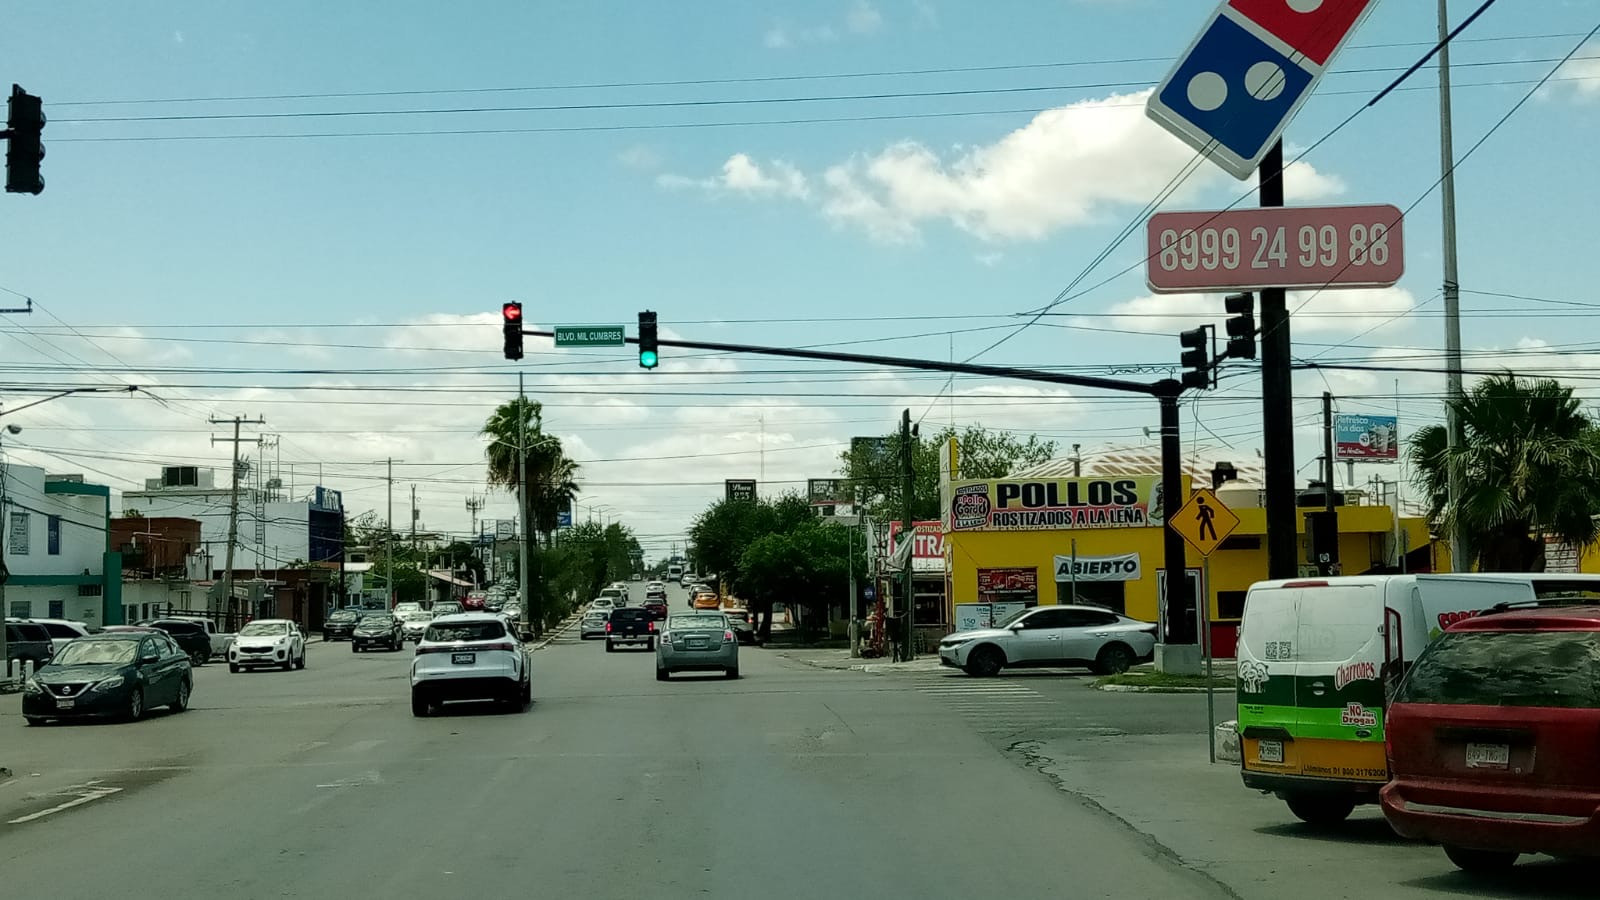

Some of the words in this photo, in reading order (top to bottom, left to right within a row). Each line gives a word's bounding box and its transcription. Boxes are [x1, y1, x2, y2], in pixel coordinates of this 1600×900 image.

[1159, 228, 1241, 271] 8999
[1251, 226, 1288, 269] 24
[1298, 224, 1338, 268] 99
[1349, 222, 1389, 266] 88
[557, 332, 577, 341] BLVD.
[577, 332, 589, 341] MIL
[589, 331, 622, 341] CUMBRES
[996, 480, 1138, 509] POLLOS
[993, 510, 1072, 527] ROSTIZADOS
[1077, 510, 1088, 524] A
[1089, 509, 1109, 524] LA
[1110, 506, 1143, 524] LEÑA
[1057, 560, 1137, 576] ABIERTO
[1336, 662, 1375, 690] Charrones
[1350, 705, 1361, 717] NO
[1343, 716, 1375, 726] Drogas
